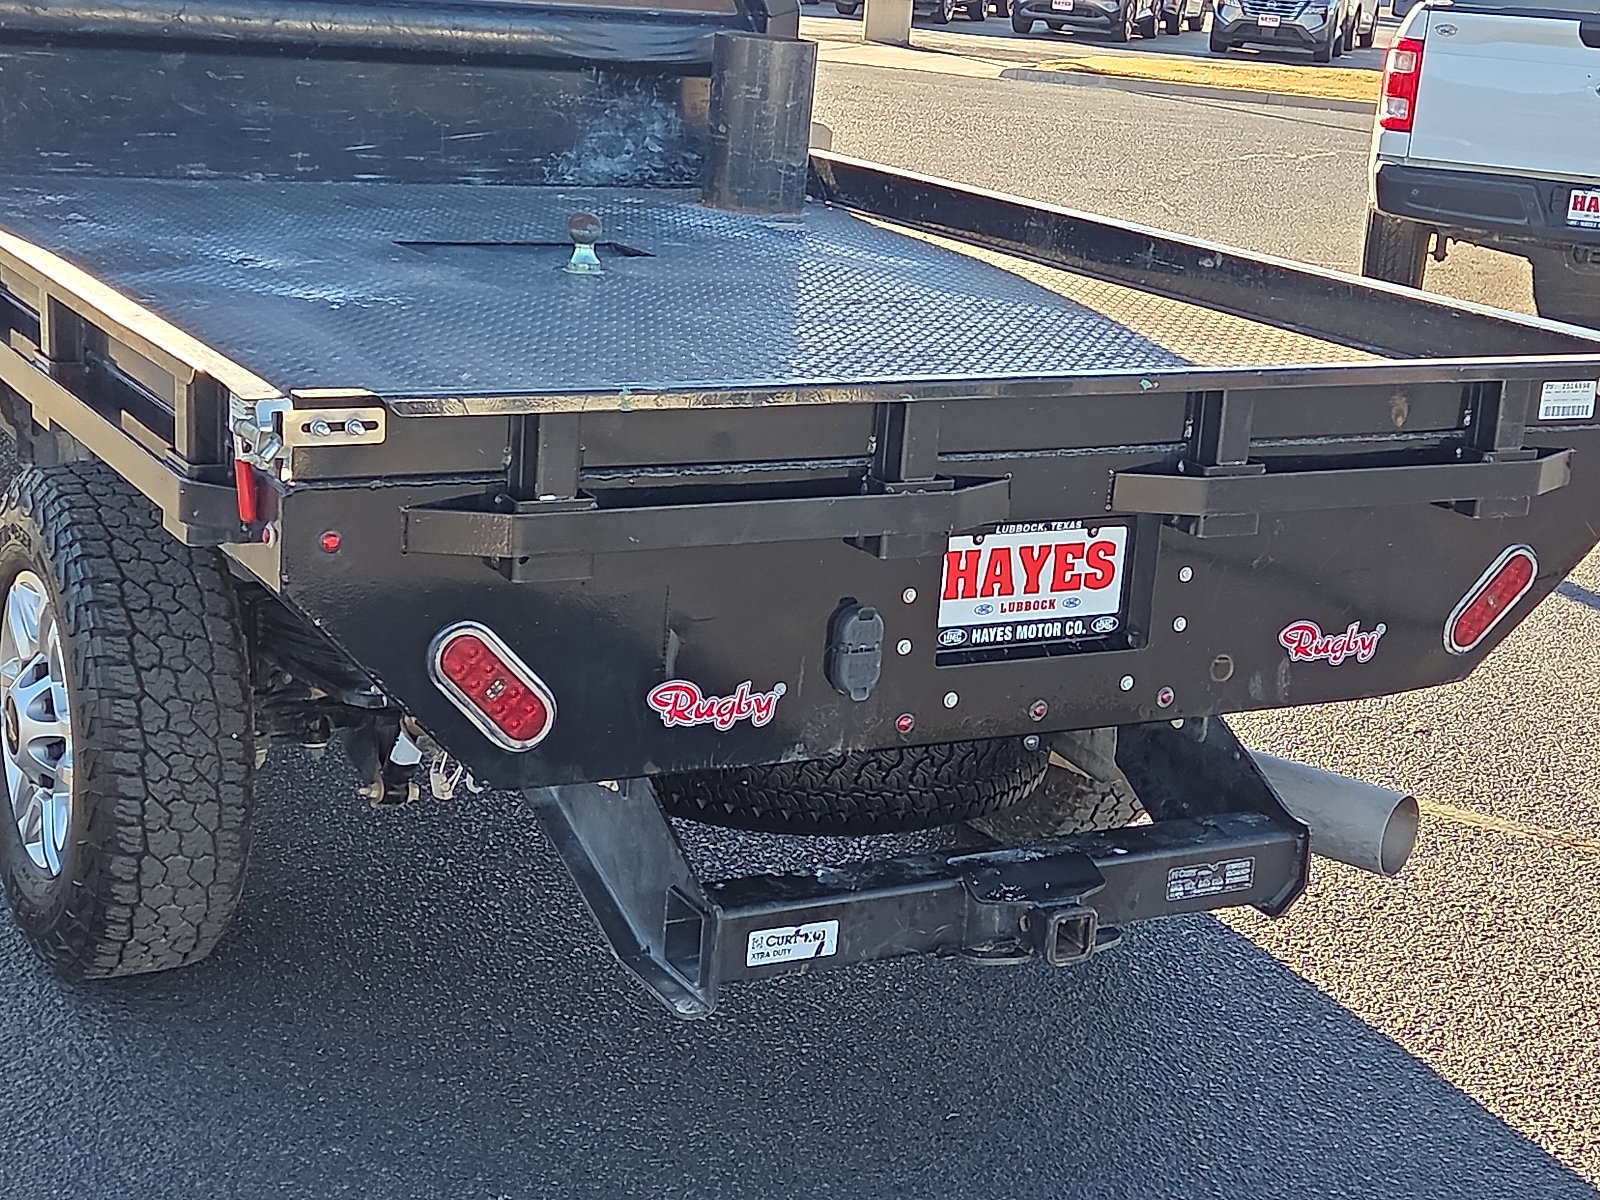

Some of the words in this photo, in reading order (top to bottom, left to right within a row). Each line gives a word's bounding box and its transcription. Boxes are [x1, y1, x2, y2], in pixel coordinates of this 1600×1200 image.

[995, 523, 1048, 534] LUBBOCK,
[1051, 520, 1083, 531] TEXAS
[943, 541, 1116, 600] HAYES
[1000, 599, 1056, 613] LUBBOCK
[971, 625, 1013, 644] HAYES
[1016, 622, 1062, 640] MOTOR
[1065, 620, 1087, 636] CO.
[1280, 622, 1377, 664] Rugby
[650, 682, 775, 729] Rugby
[751, 951, 771, 960] XTRA
[773, 949, 792, 957] DUTY
